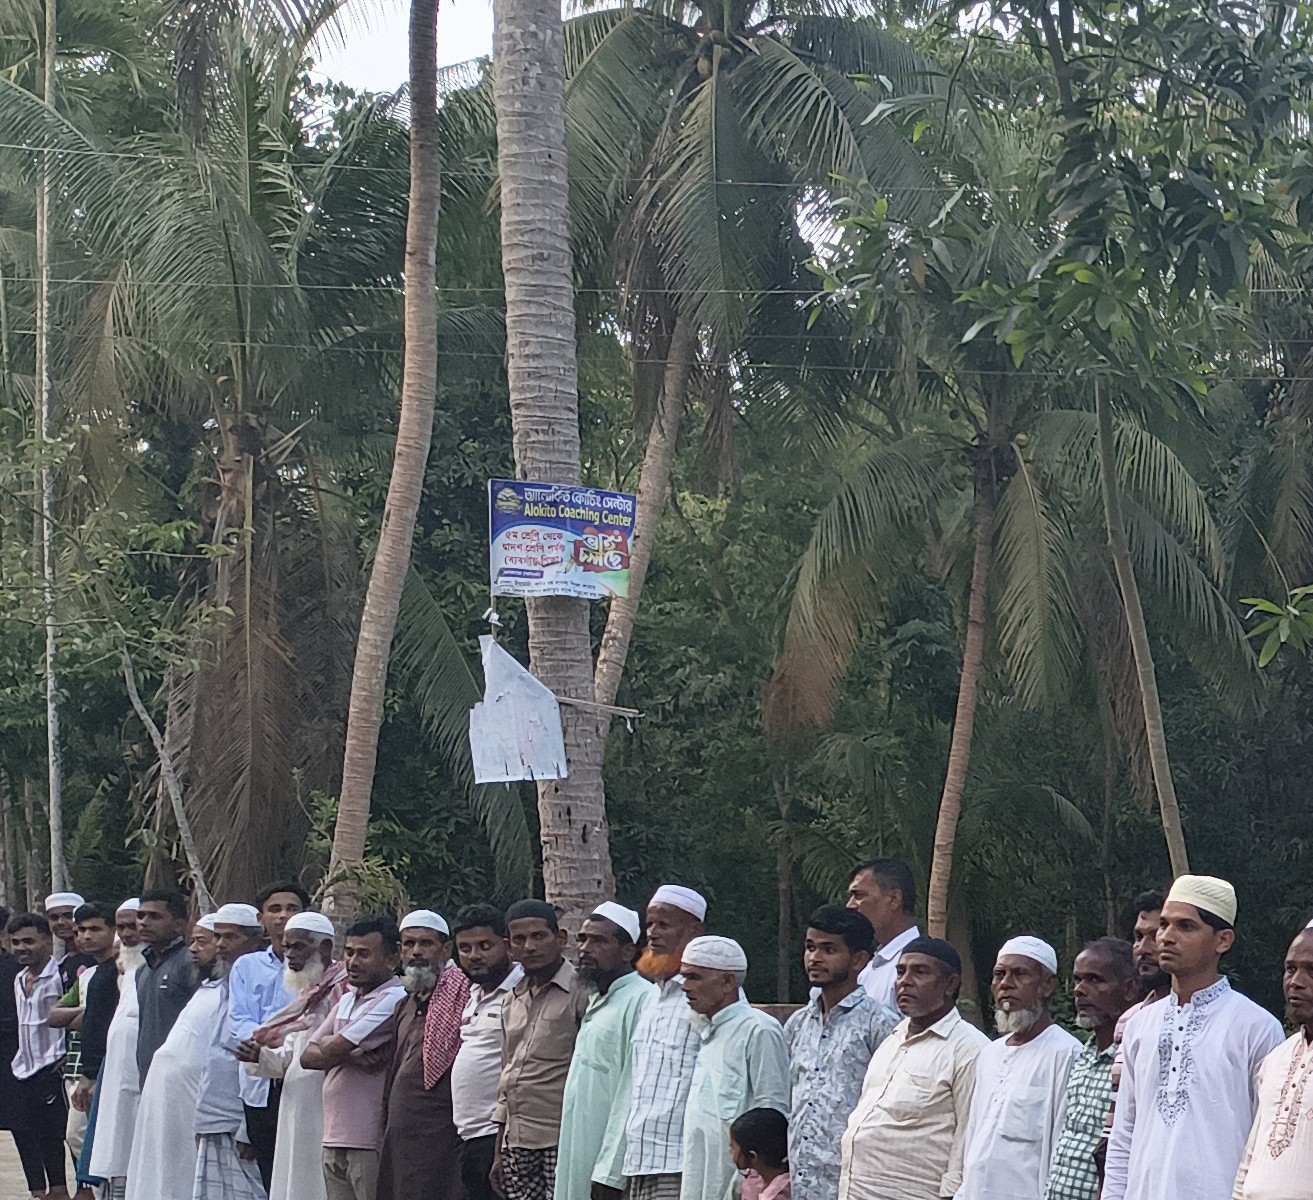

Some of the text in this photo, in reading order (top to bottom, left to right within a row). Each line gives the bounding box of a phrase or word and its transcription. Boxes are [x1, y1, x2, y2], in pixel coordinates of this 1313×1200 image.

[572, 489, 602, 507] কোচিং
[603, 495, 632, 513] সেন্টার
[524, 503, 556, 517] Alokito
[558, 505, 600, 525] Coaching
[602, 511, 632, 526] Center
